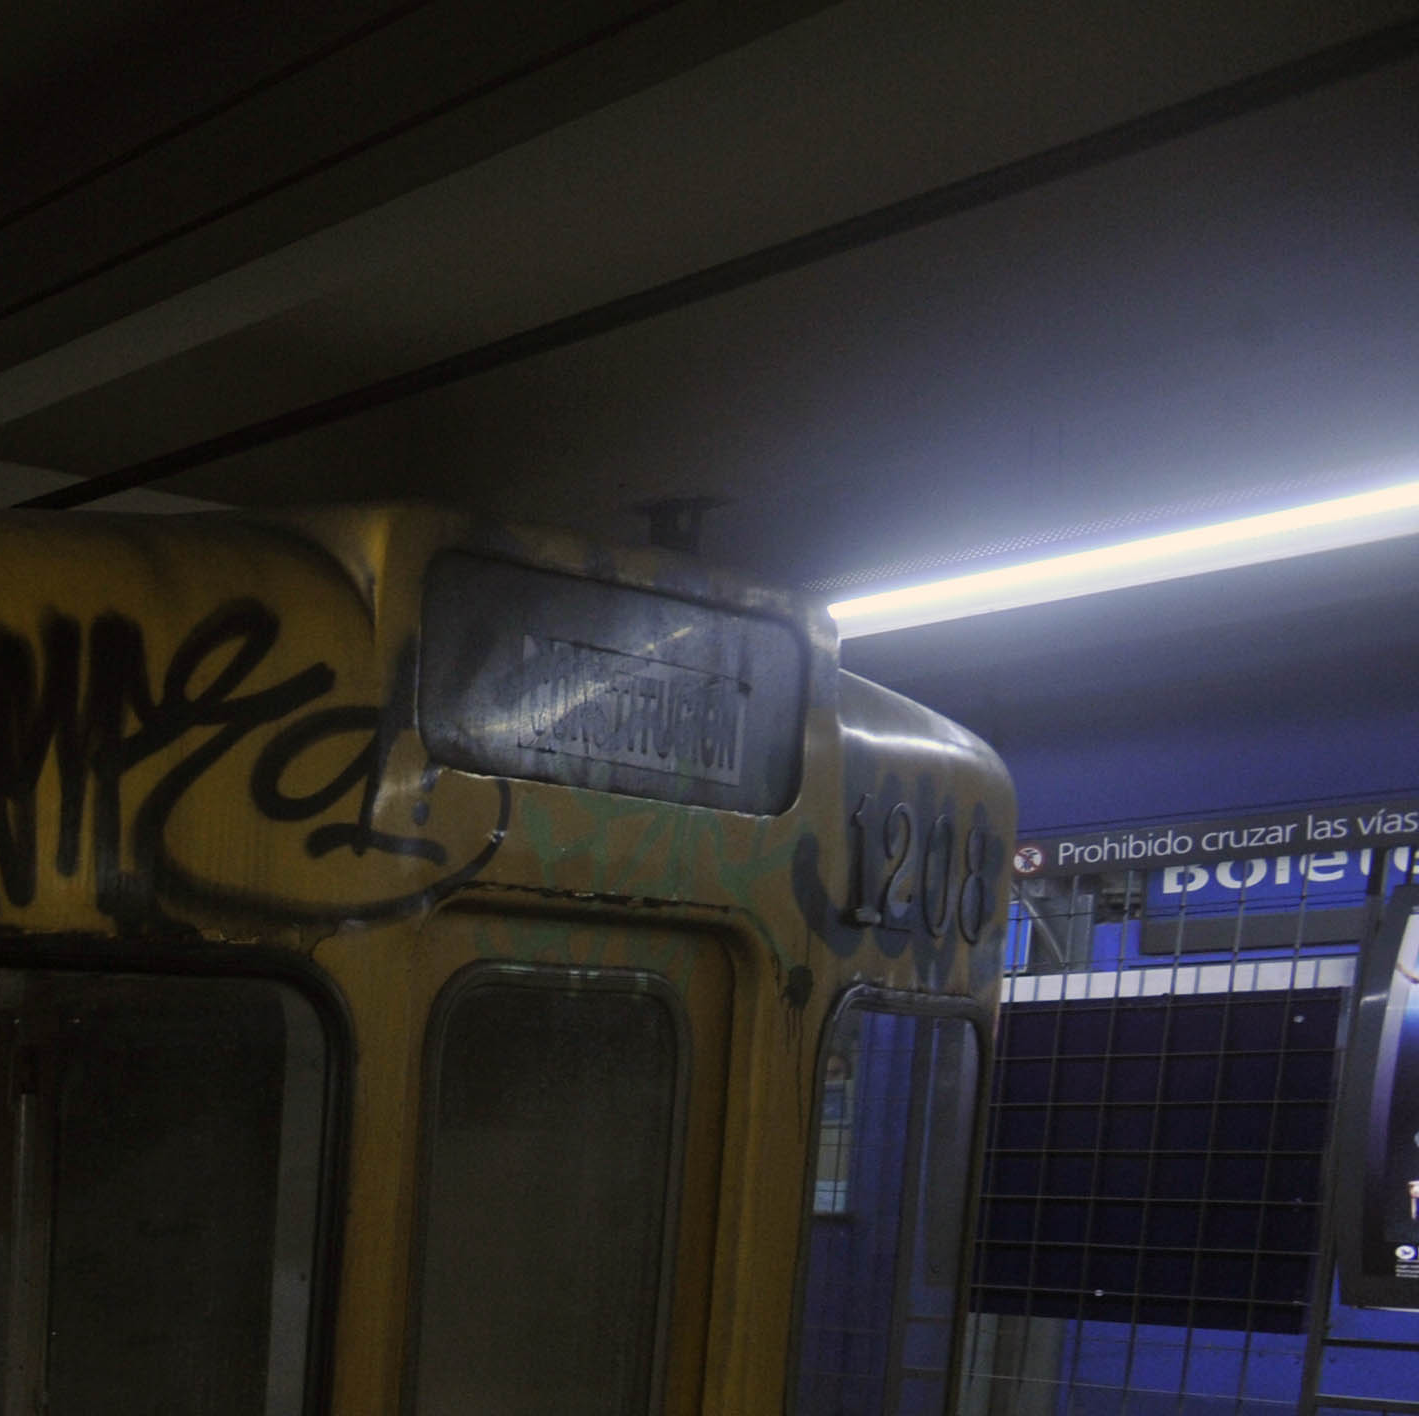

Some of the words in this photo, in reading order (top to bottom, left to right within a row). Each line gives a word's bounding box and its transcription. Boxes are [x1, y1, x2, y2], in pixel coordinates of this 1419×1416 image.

[1058, 830, 1193, 866] Prohibido
[1201, 822, 1298, 853] cruzar
[1306, 814, 1349, 842] las
